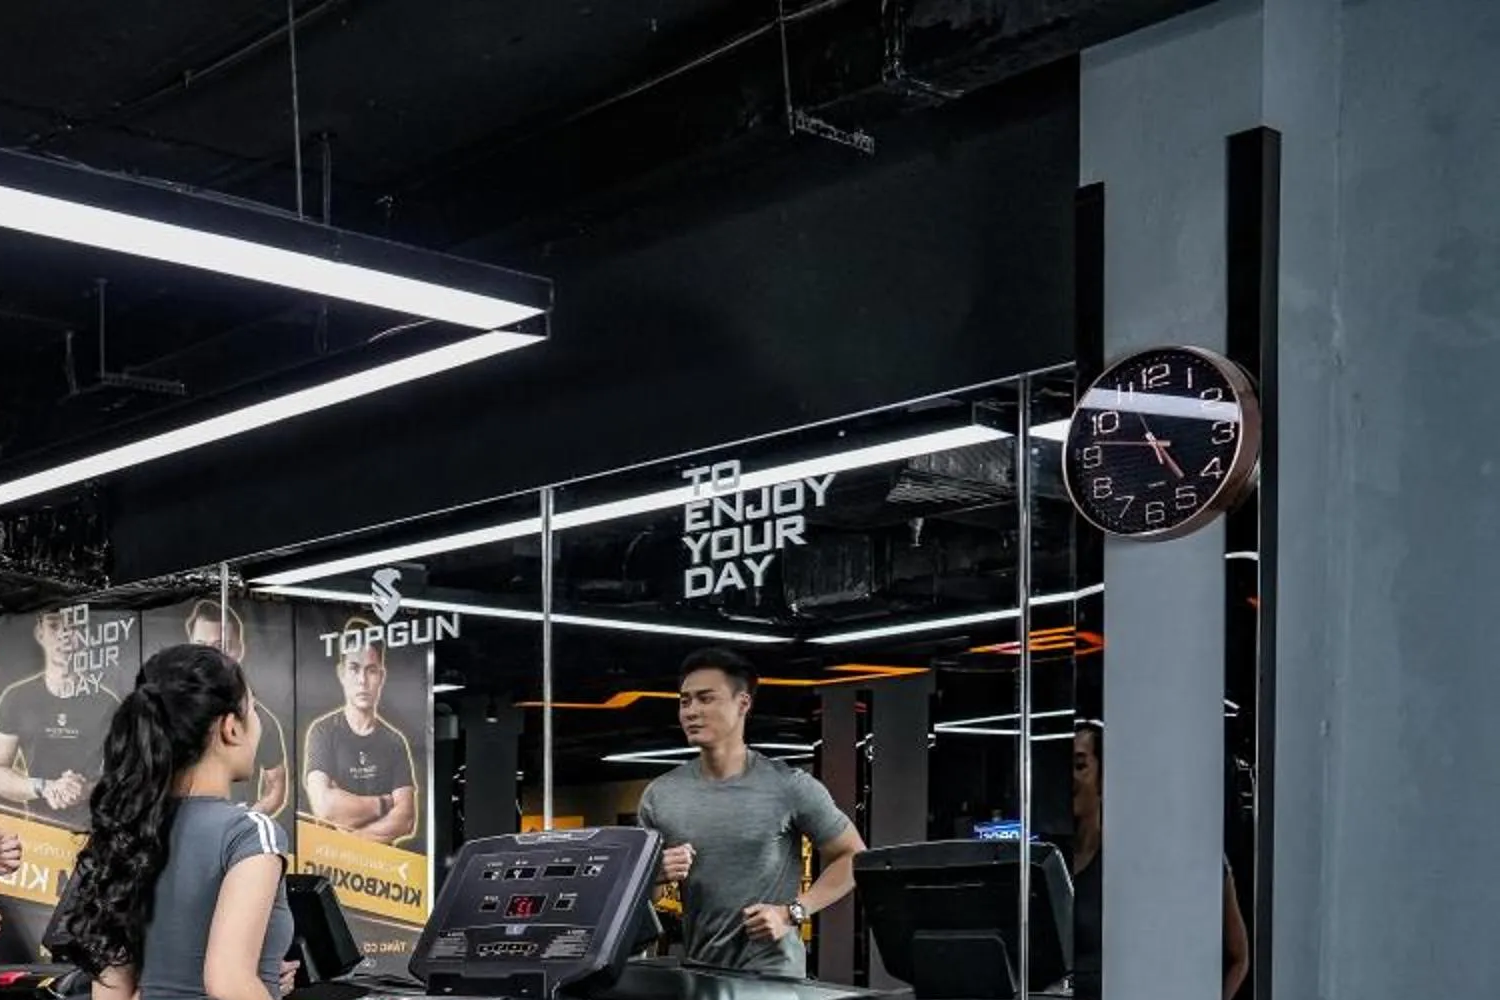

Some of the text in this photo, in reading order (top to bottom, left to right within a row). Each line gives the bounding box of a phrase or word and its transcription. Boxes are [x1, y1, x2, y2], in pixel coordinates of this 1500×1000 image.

[1142, 364, 1170, 389] 12
[1187, 367, 1193, 388] 1
[1091, 411, 1119, 436] 10
[1212, 421, 1235, 445] 3
[1083, 445, 1102, 469] 9
[1200, 457, 1224, 479] 4
[682, 459, 741, 497] TO
[1093, 477, 1112, 498] 8
[685, 473, 836, 532] ENJOY
[1115, 495, 1136, 518] 7
[1175, 485, 1197, 510] 5
[1145, 501, 1165, 524] 6
[682, 515, 808, 564] YOUR
[684, 554, 775, 598] DAY
[60, 604, 89, 627] TO
[59, 617, 135, 650] ENJOY
[320, 613, 460, 657] TOPGUN
[64, 645, 119, 674] YOUR
[61, 672, 103, 699] DAY
